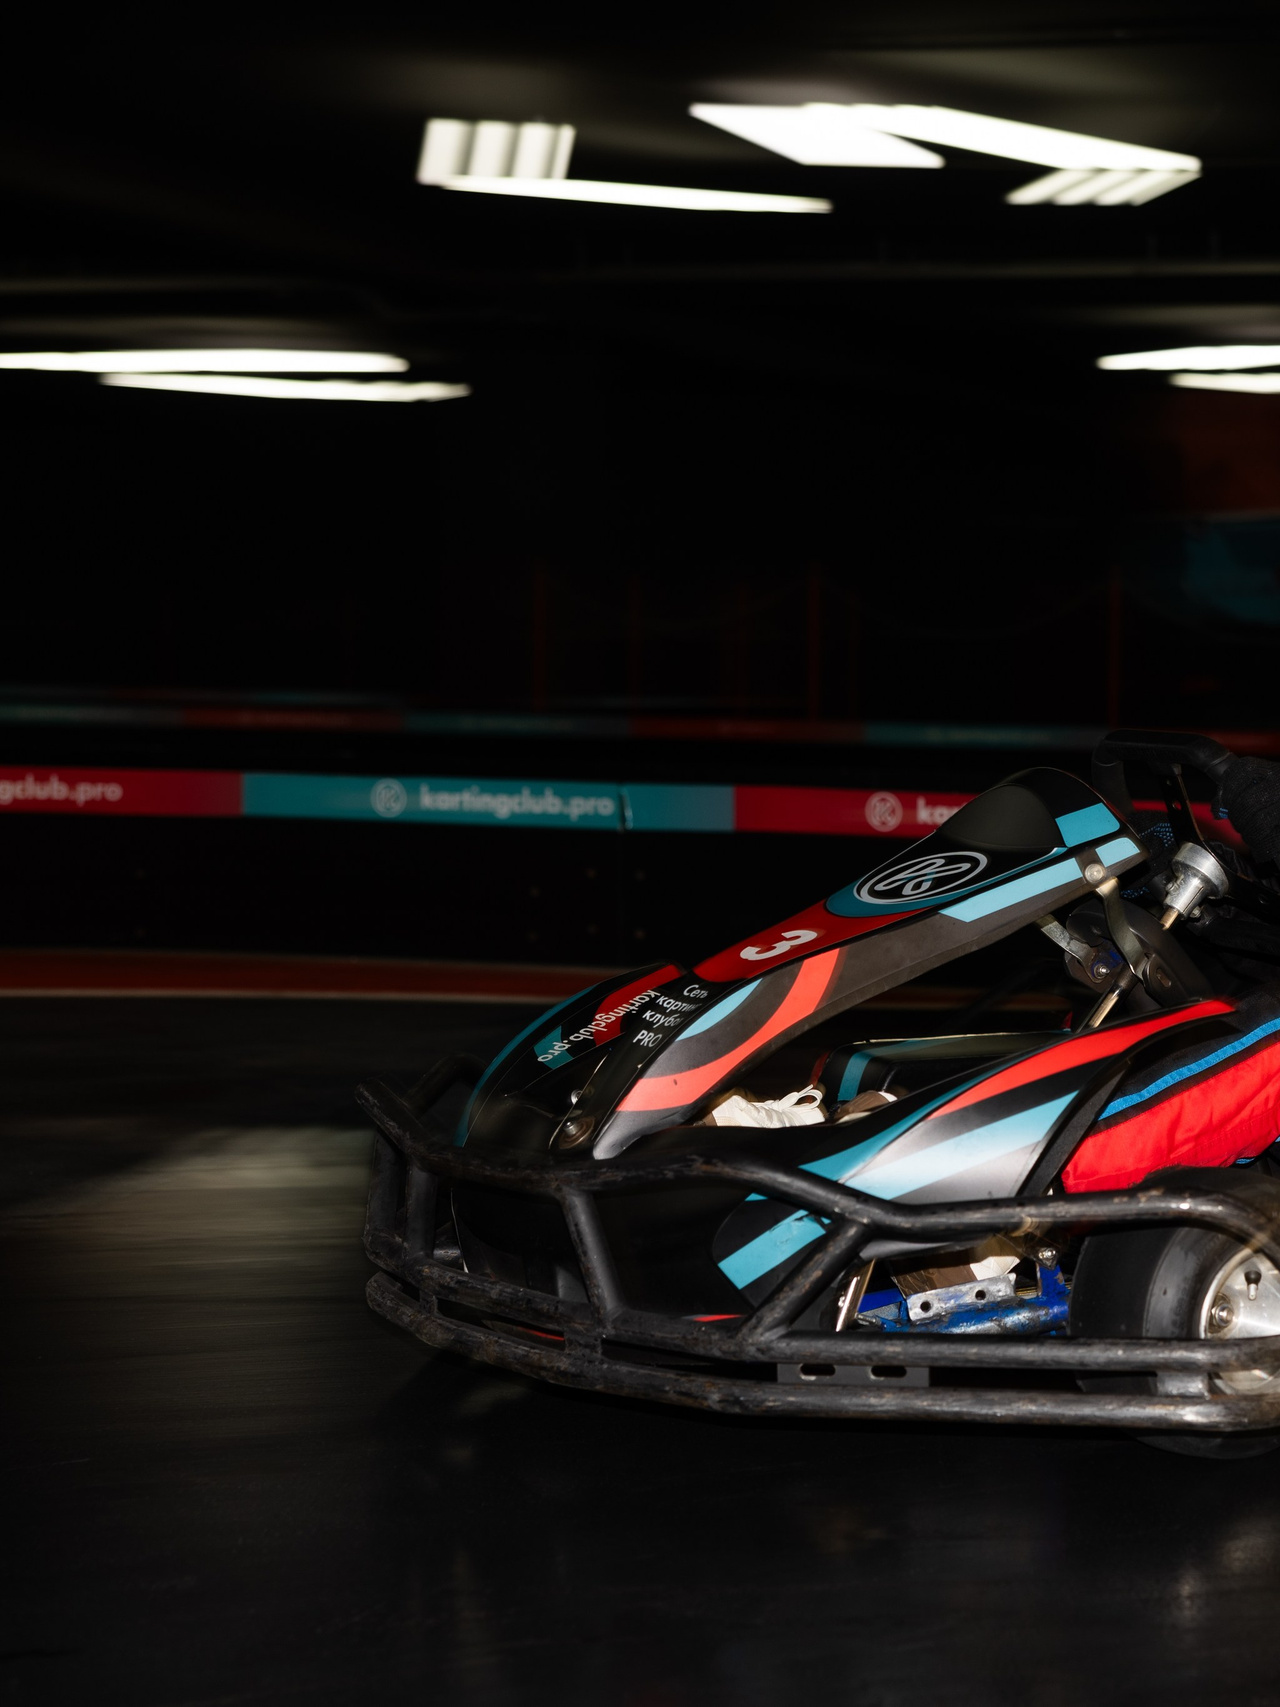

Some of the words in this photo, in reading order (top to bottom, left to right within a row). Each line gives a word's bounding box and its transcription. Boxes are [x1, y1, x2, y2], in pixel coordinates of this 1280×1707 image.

[419, 781, 616, 822] kartingclub.pro
[740, 929, 818, 961] 3
[683, 984, 709, 999] Сеть
[537, 989, 661, 1063] kartingclub.pro
[642, 1010, 684, 1028] клубо
[632, 1029, 663, 1048] PRO
